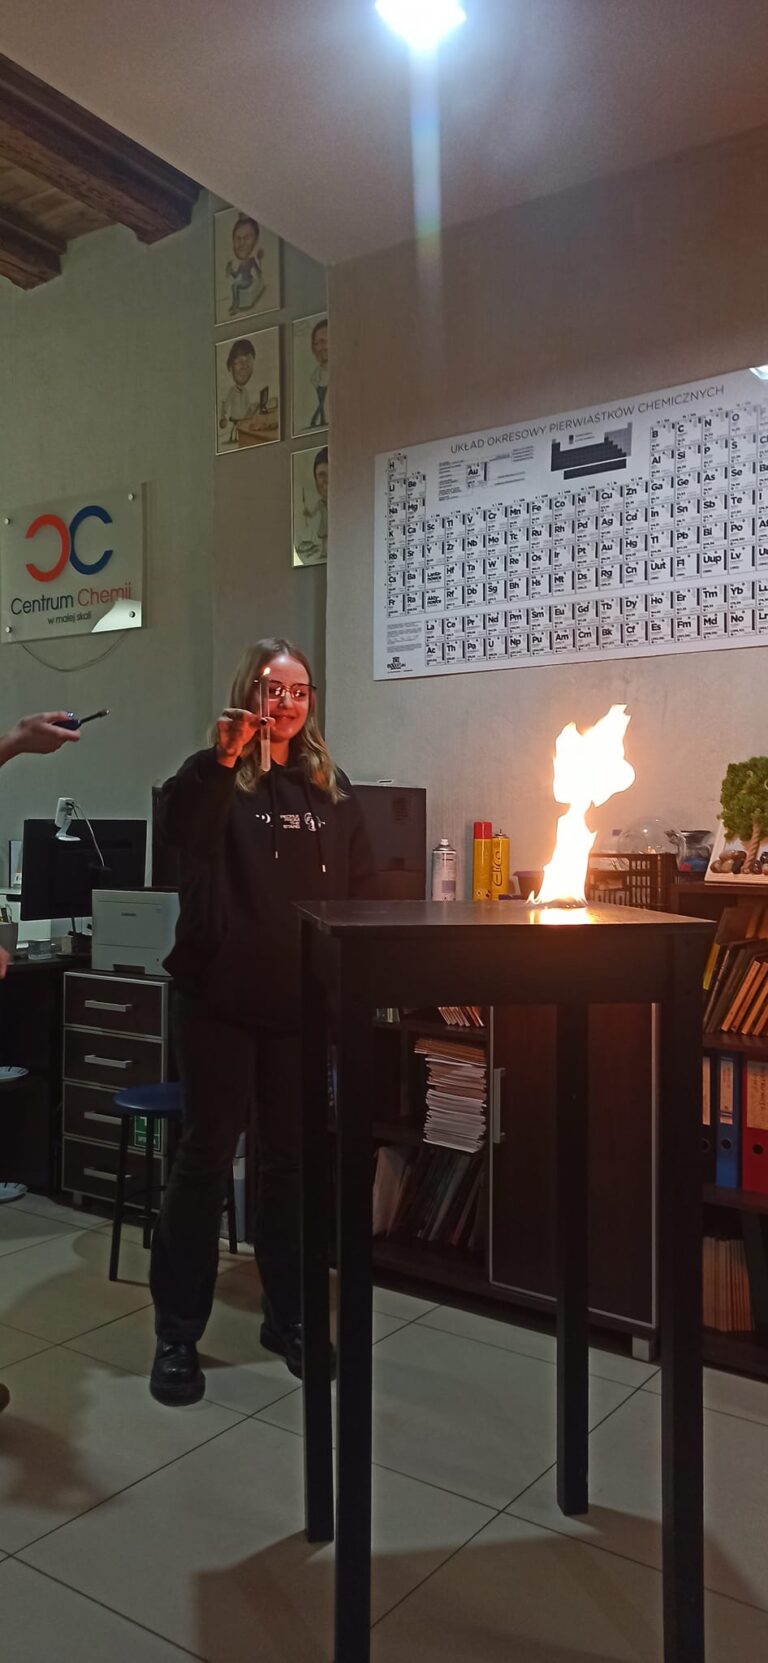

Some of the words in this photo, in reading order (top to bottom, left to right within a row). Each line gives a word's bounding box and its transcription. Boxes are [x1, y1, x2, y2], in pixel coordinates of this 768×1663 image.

[450, 439, 484, 454] UKŁAD
[487, 426, 547, 447] OKRESOWY
[550, 405, 636, 432] PIERWIASTKÓW
[638, 385, 724, 414] CHEMICZNYCH
[732, 413, 740, 422] O
[704, 418, 712, 427] N
[652, 430, 658, 438] B
[731, 441, 738, 450] S
[704, 446, 710, 454] P
[678, 450, 686, 460] Si
[652, 456, 660, 464] Al
[731, 469, 742, 477] Se
[704, 474, 715, 482] As
[651, 482, 662, 490] Ga
[731, 496, 742, 504] Te
[704, 501, 716, 510] Sb
[677, 506, 688, 514] Sn
[626, 513, 637, 521] Cd
[578, 521, 588, 529] Pd
[601, 518, 613, 526] Ag
[704, 528, 712, 536] Bi
[731, 524, 742, 532] Po
[677, 532, 688, 540] Pb
[601, 544, 612, 552] Au
[626, 540, 638, 548] Hg
[578, 547, 586, 555] Pt
[704, 555, 722, 564] Uup
[731, 552, 741, 560] Lv
[651, 562, 666, 570] Uut
[677, 559, 684, 567] Fl
[601, 570, 612, 578] Rg
[626, 566, 637, 574] Cn
[488, 586, 498, 594] Sg
[704, 590, 718, 598] Tm
[731, 587, 743, 596] Yb
[11, 594, 74, 616] Centrum
[77, 582, 132, 607] Chemii
[578, 604, 589, 612] Gd
[626, 600, 637, 608] Dy
[48, 616, 54, 624] w
[76, 611, 92, 622] skali
[704, 616, 718, 626] Md
[677, 620, 691, 629] Fm
[555, 633, 568, 641] Am
[510, 638, 520, 646] Np
